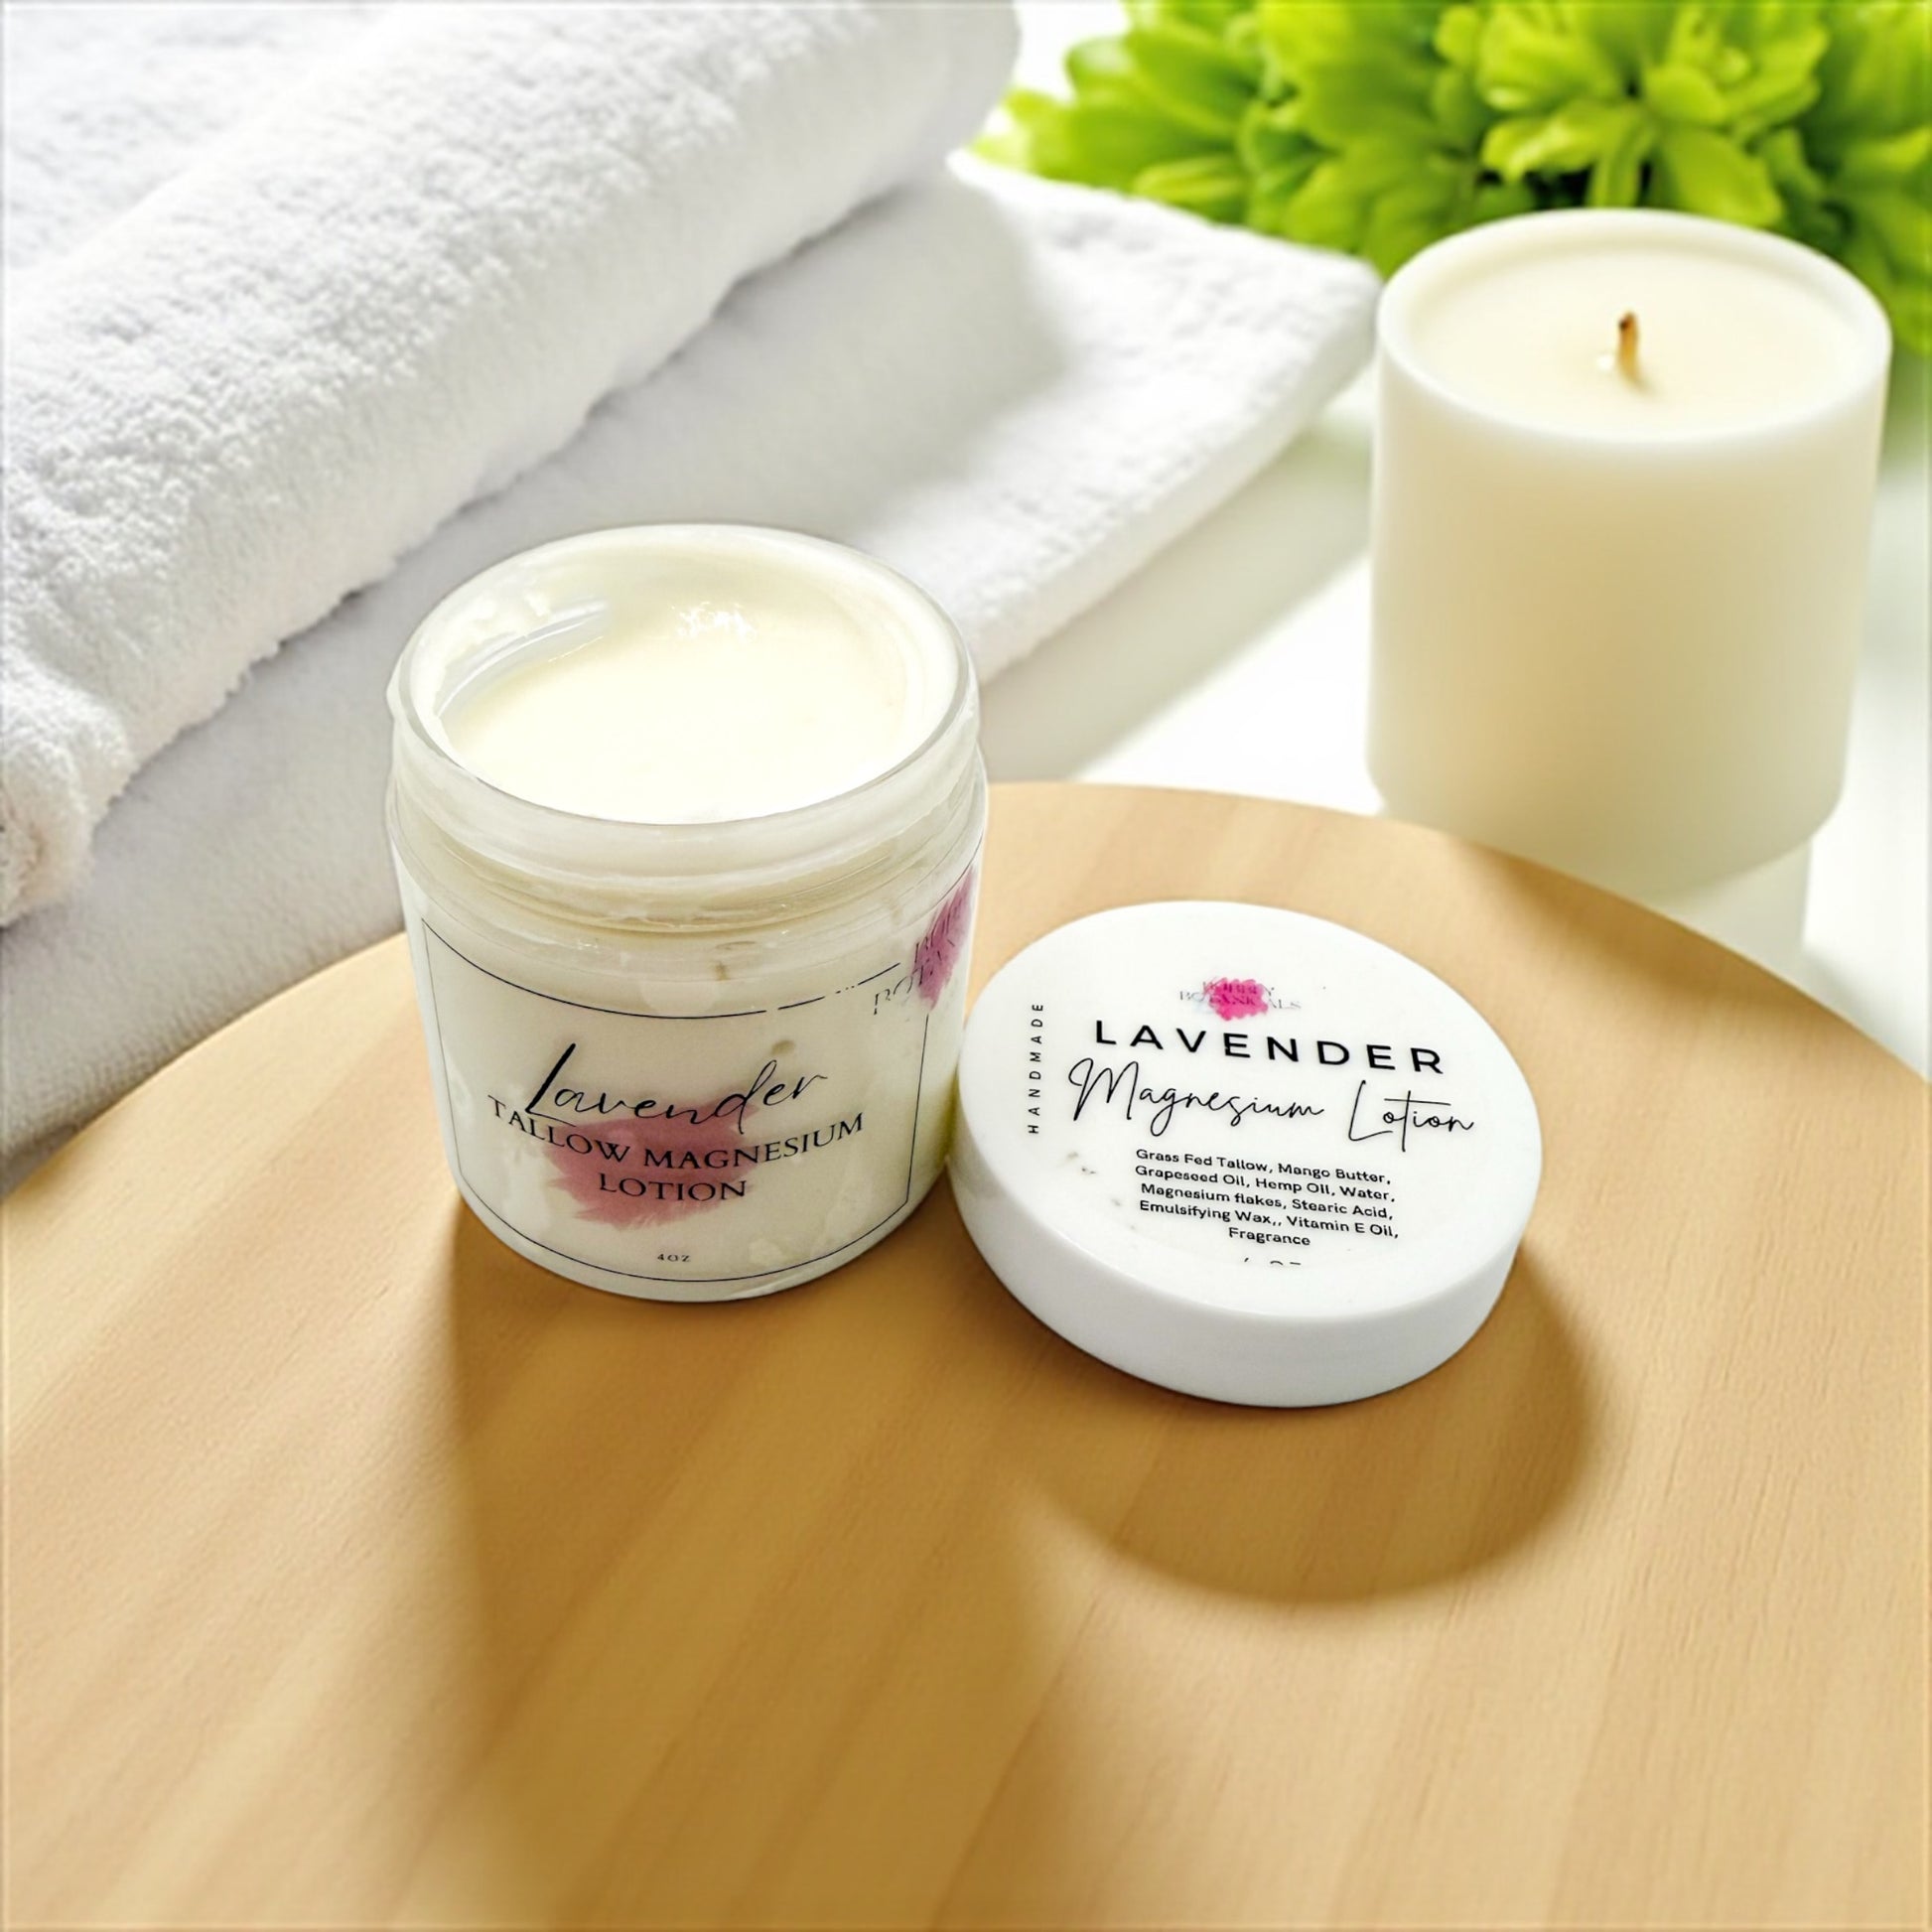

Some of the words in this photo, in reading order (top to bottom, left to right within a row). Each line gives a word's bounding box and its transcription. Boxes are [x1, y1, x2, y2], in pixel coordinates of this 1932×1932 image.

[1095, 1020, 1444, 1074] LAVENDER
[525, 1042, 828, 1135] Lavender
[1027, 1004, 1043, 1134] HANDMADE
[1068, 1057, 1324, 1137] Magnesium
[1348, 1079, 1474, 1152] Lotion
[487, 1094, 630, 1163] TALLOW
[643, 1112, 864, 1170] MAGNESIUM
[1135, 1165, 1218, 1182] Grapeseed
[1222, 1173, 1250, 1187] Oil,
[1256, 1177, 1302, 1193] Hemp
[1339, 1185, 1395, 1202] Water,
[1136, 1149, 1179, 1163] Grass
[1184, 1154, 1212, 1167] Fed
[1216, 1157, 1273, 1173] Tallow,
[1278, 1163, 1330, 1179] Mango
[1335, 1169, 1391, 1184] Butter,
[599, 1173, 747, 1201] LOTION
[1141, 1182, 1230, 1202] Magnesium
[1234, 1193, 1287, 1209] flakes,
[1292, 1198, 1347, 1214] Stearic
[1352, 1205, 1393, 1220] Acid,
[1140, 1199, 1231, 1222] Emulsifying
[1286, 1215, 1349, 1232] Vitamin
[1354, 1222, 1365, 1233] E
[1369, 1223, 1399, 1239] Oil,
[1229, 1226, 1311, 1246] Fragrance
